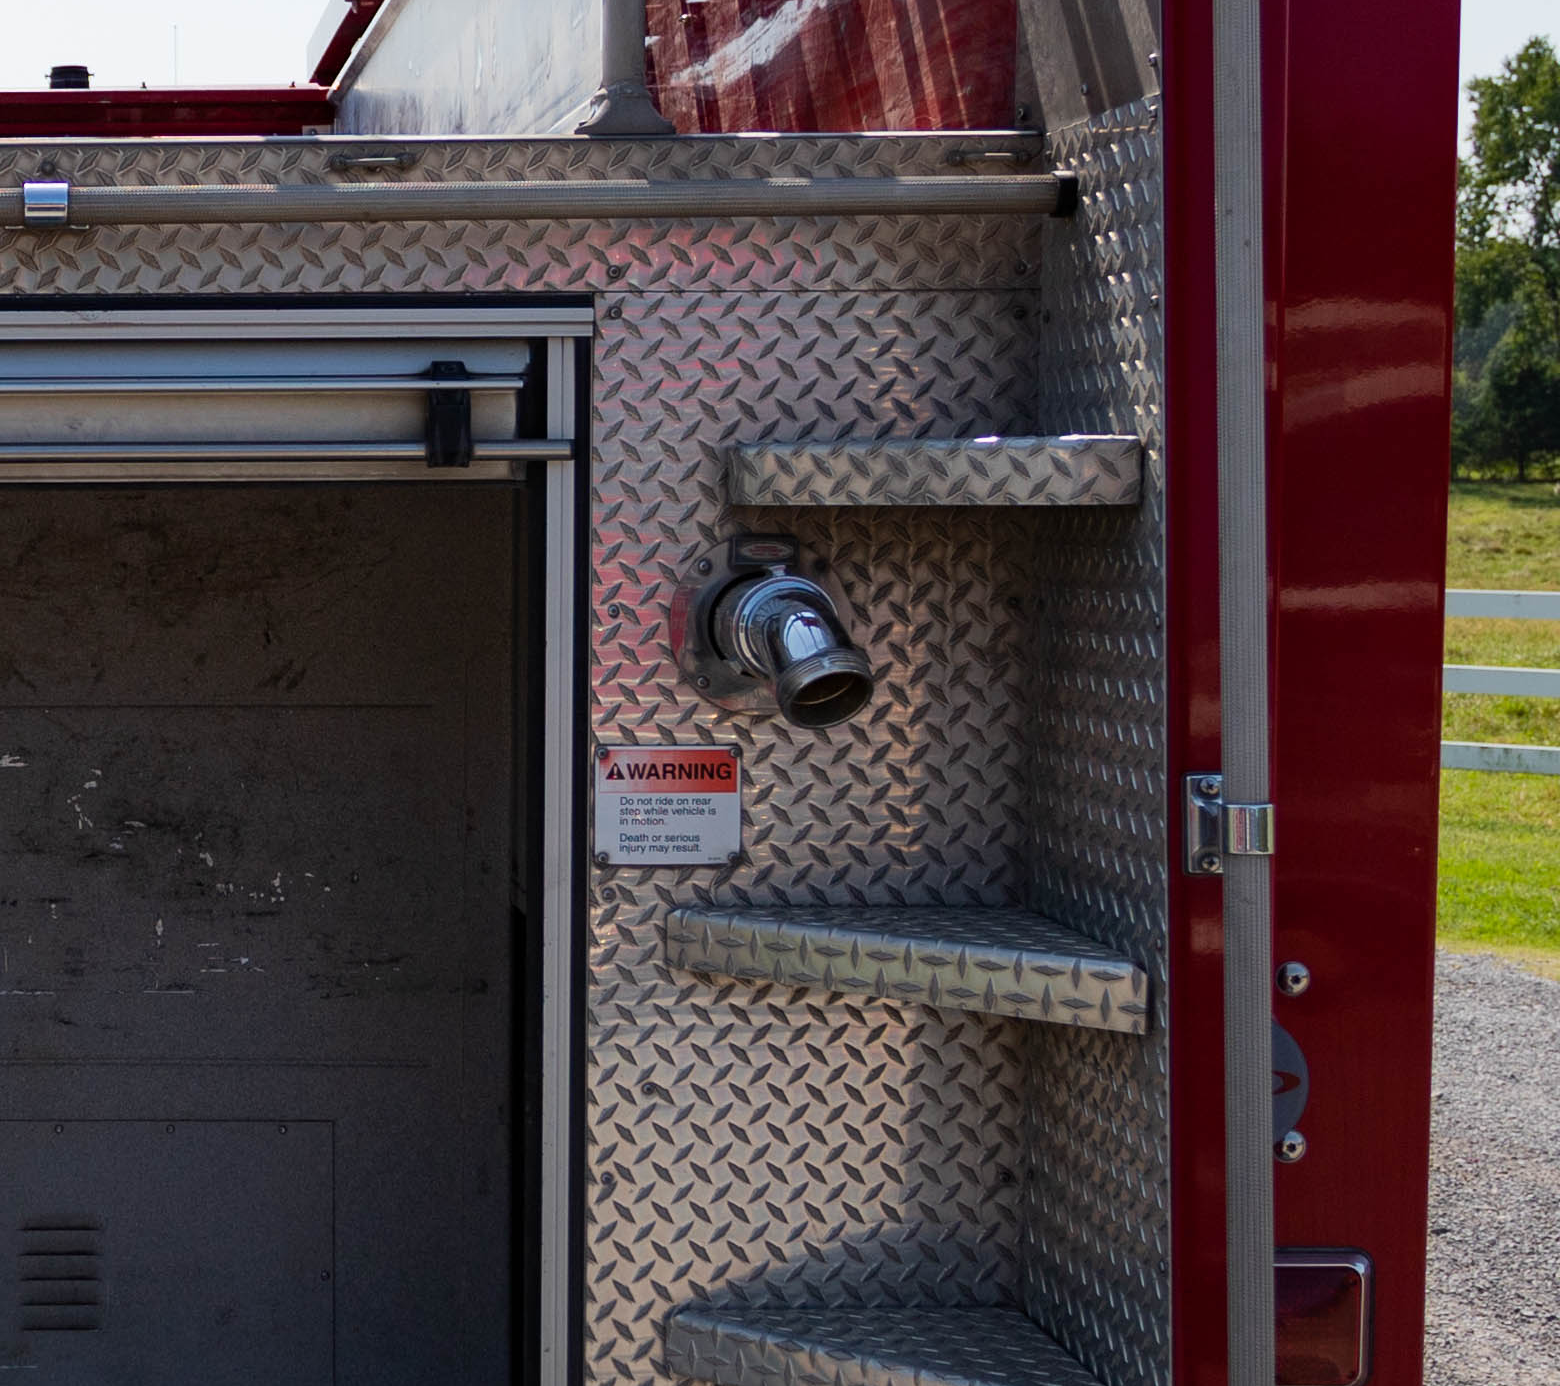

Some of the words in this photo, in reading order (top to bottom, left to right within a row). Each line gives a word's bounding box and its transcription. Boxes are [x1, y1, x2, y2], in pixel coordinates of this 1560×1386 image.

[626, 763, 732, 780] WARNING
[620, 796, 634, 806] Do
[637, 797, 653, 806] not
[655, 796, 674, 806] ride
[676, 798, 689, 806] on
[692, 798, 712, 806] rear
[620, 807, 641, 817] step
[643, 806, 669, 816] while
[672, 806, 706, 816] vehicle
[708, 807, 717, 816] is
[620, 817, 629, 826] in
[620, 833, 649, 843] Death
[651, 834, 662, 843] or
[664, 833, 701, 843] serious
[619, 844, 647, 855] injury
[649, 844, 670, 854] may
